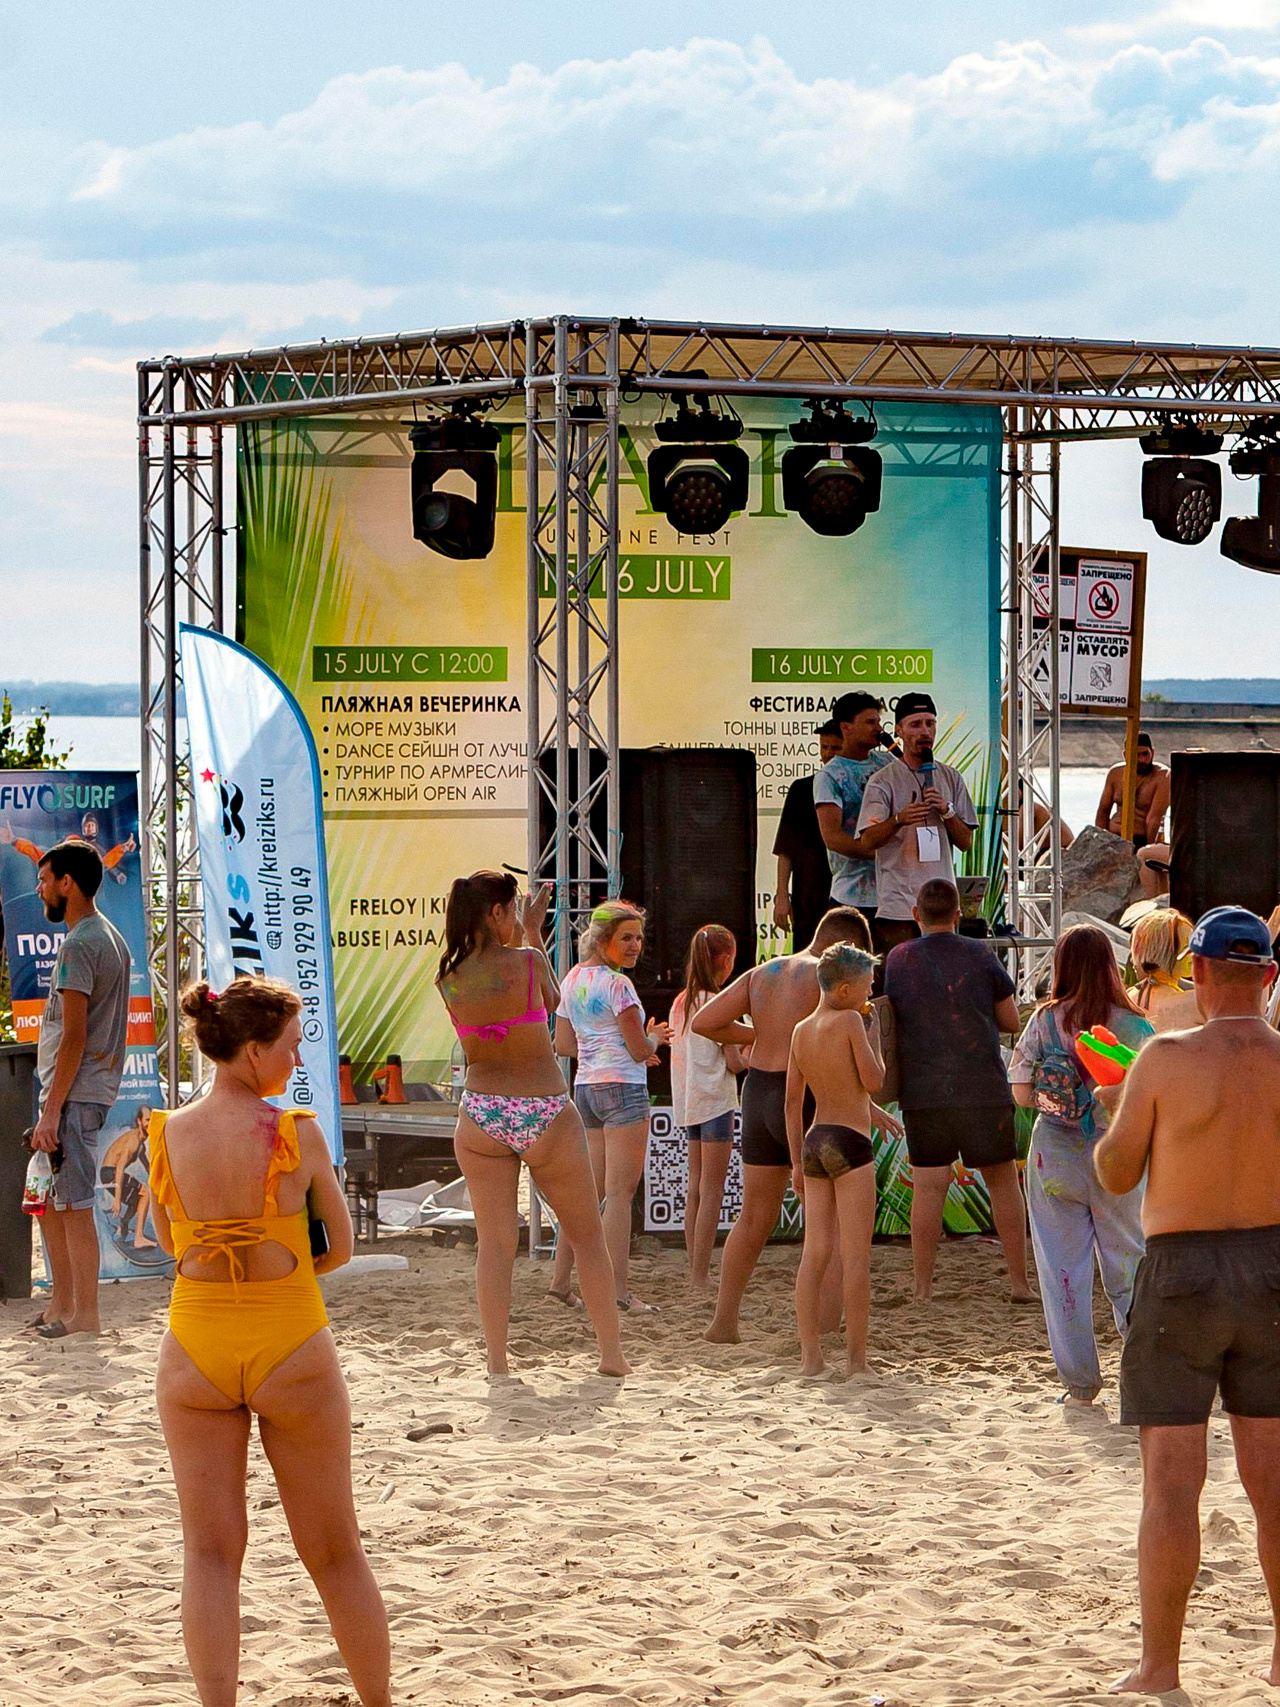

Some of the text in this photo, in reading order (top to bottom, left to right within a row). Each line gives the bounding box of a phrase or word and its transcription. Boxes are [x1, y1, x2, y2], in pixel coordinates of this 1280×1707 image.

[677, 530, 732, 546] FEST
[646, 559, 725, 594] JULY
[1080, 569, 1133, 581] ЗАПРЕЩЕНО
[1076, 634, 1130, 646] ОСТАВЛЯТЬ
[1076, 643, 1129, 658] МУСОР
[323, 652, 347, 674] 15
[353, 652, 405, 674] JULY
[439, 652, 494, 674] 12:00
[769, 654, 791, 676] 16
[797, 654, 844, 676] JULY
[876, 654, 928, 676] 13:00
[321, 696, 522, 713] ПЛЯЖНАЯ ВЕЧЕРИНКА
[1075, 693, 1127, 704] ЗАПРЕЩЕНО
[335, 721, 457, 737] МОРЕ МУЗЫКИ
[723, 721, 777, 736] ТОННЫ
[335, 743, 394, 758] DANCE
[398, 740, 459, 758] СЕЙШН
[463, 742, 485, 758] ОТ
[782, 741, 820, 758] МАС
[335, 764, 529, 781] ТУРНИР ПО АРМРЕСЛИН
[0, 784, 116, 810] FLY SURF
[335, 784, 497, 801] ПЛЯЖНЫЙ OPEN AIR
[256, 778, 286, 928] http://kreiziks.ru
[290, 866, 312, 888] 49
[292, 894, 314, 916] 90
[17, 932, 67, 957] ПОЛ
[293, 922, 316, 953] 929
[296, 959, 319, 990] 952
[127, 1012, 153, 1026] ЦИИ?
[122, 1053, 158, 1076] ИНГ
[292, 1066, 314, 1105] @kr
